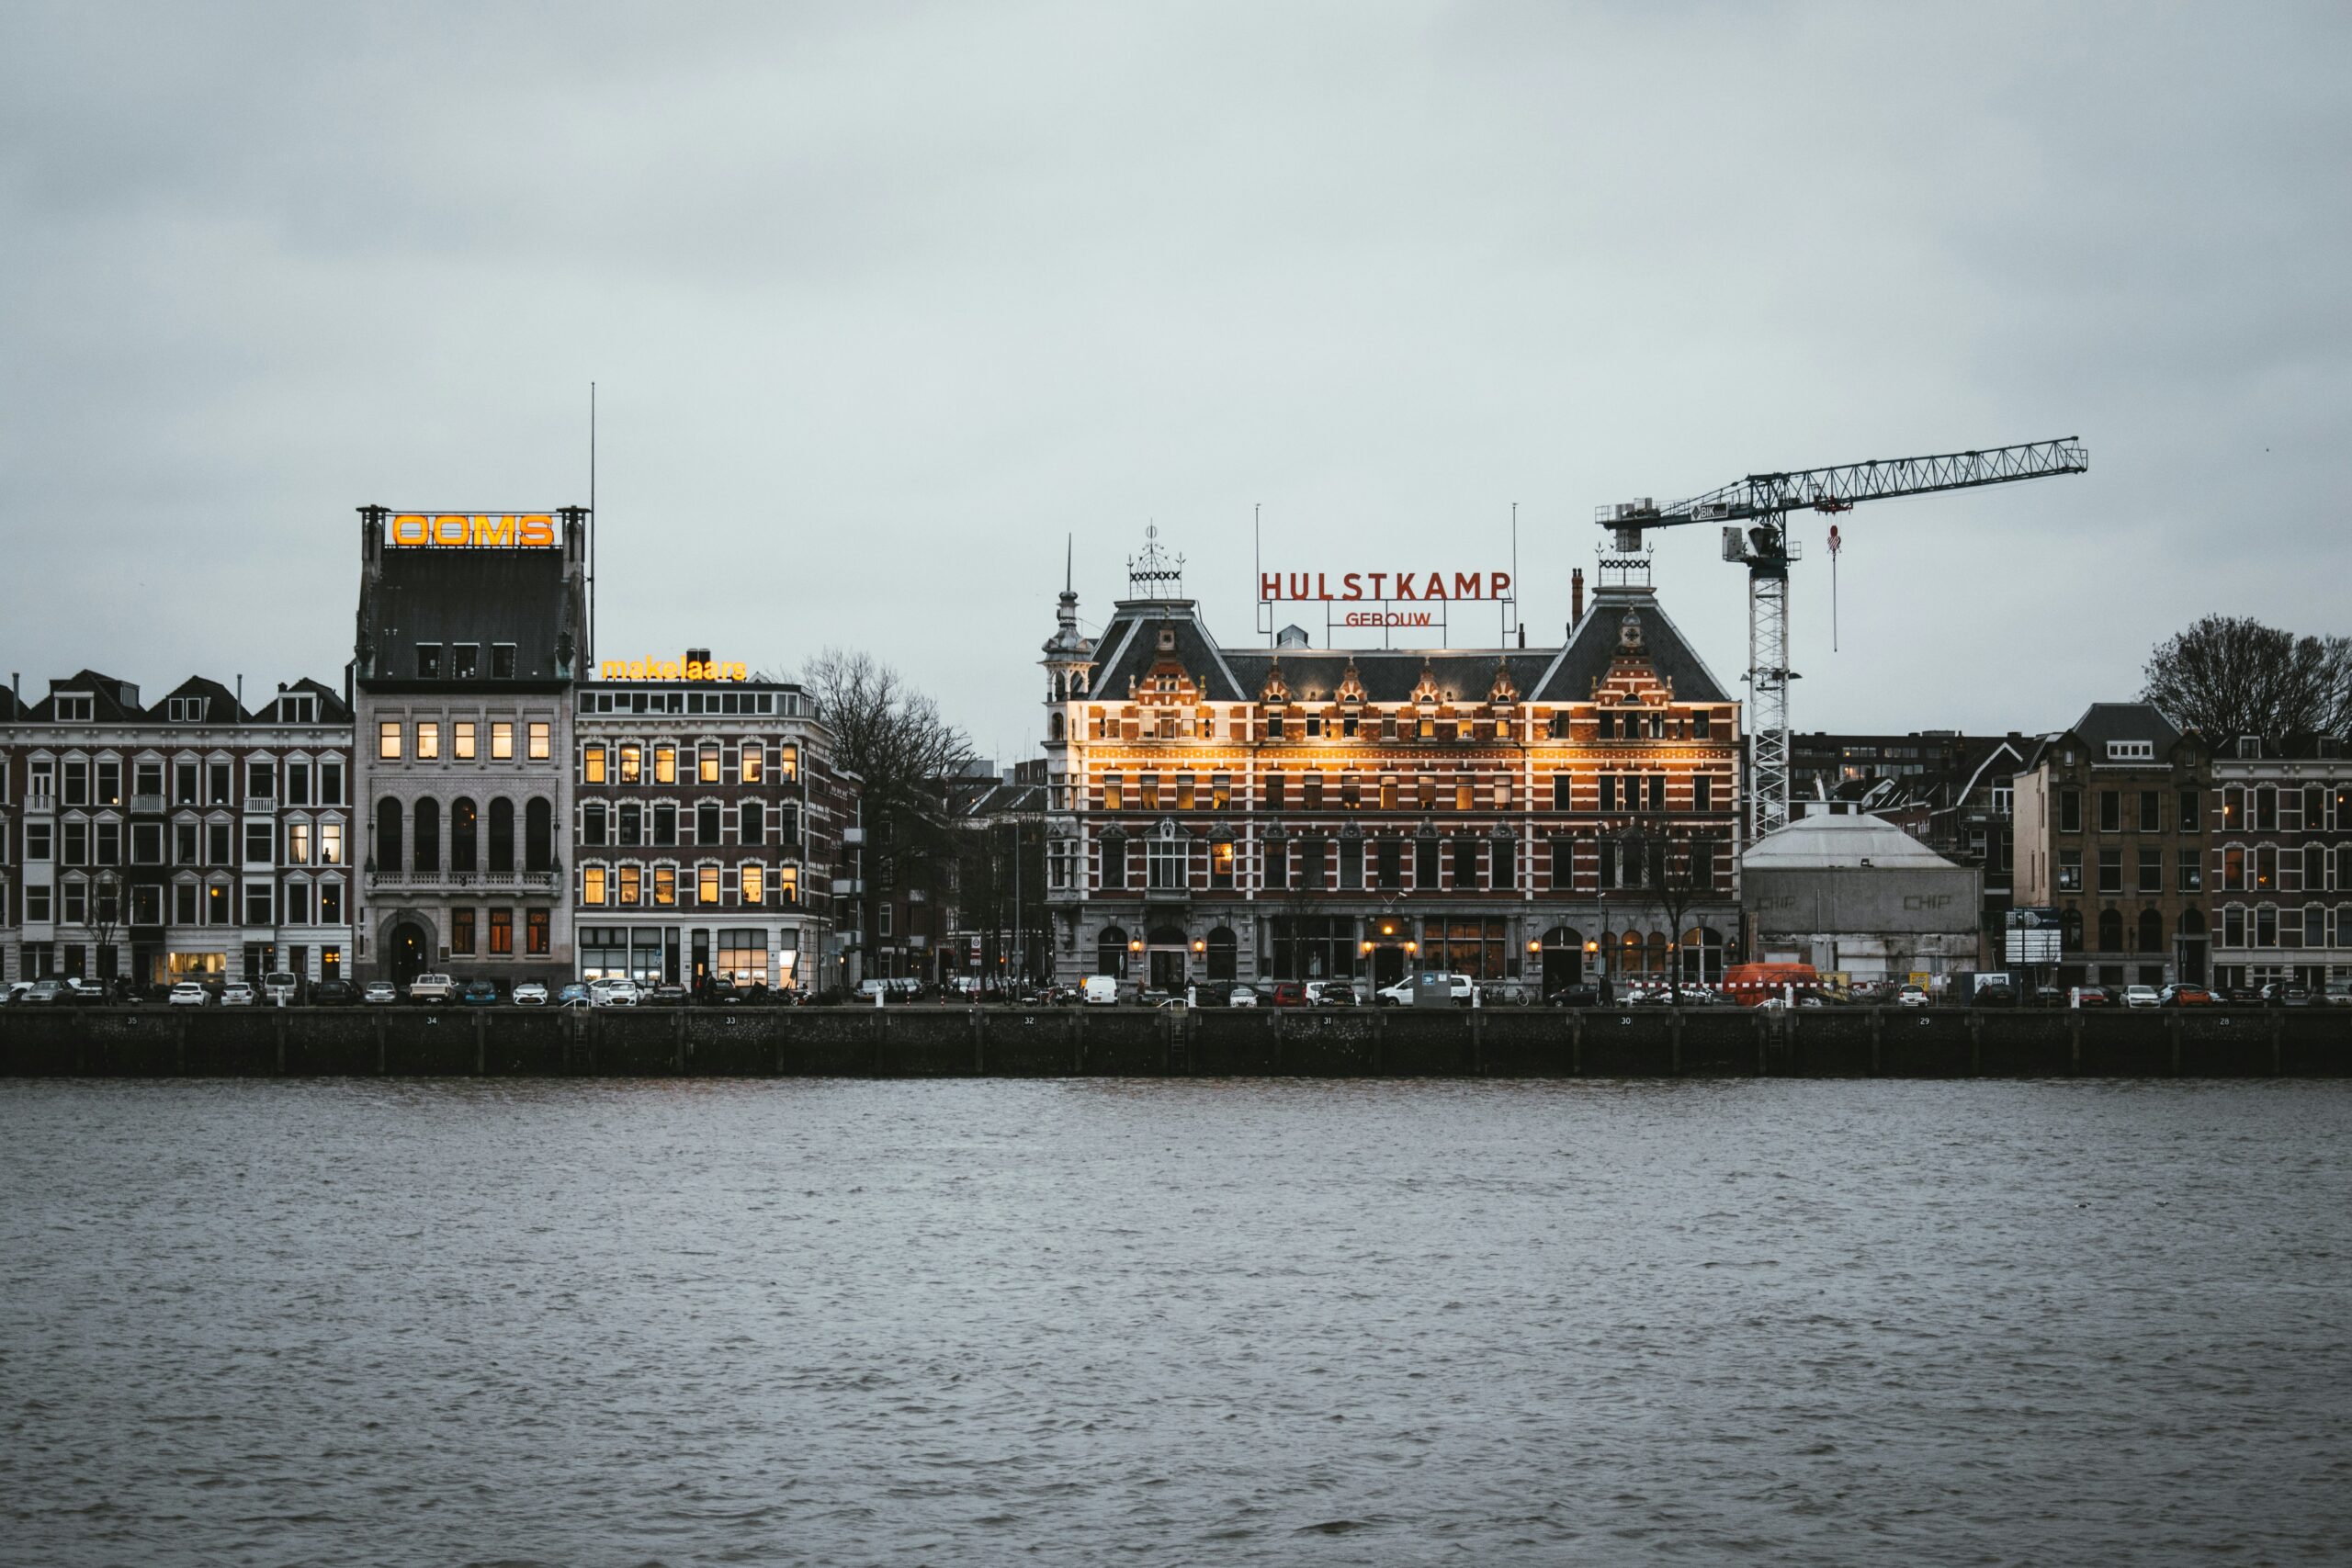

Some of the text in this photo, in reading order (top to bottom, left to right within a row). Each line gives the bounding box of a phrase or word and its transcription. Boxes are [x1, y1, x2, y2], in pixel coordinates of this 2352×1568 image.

[1702, 506, 1714, 517] BIK
[392, 514, 555, 547] OOMS
[1261, 572, 1510, 601] HULSTKAMP
[1346, 613, 1431, 626] GEBOUW
[602, 654, 747, 681] makelaars
[1904, 895, 1951, 910] CHIP
[1323, 1017, 1331, 1025] 31
[1621, 1017, 1632, 1025] 30
[1920, 1017, 1930, 1025] 29
